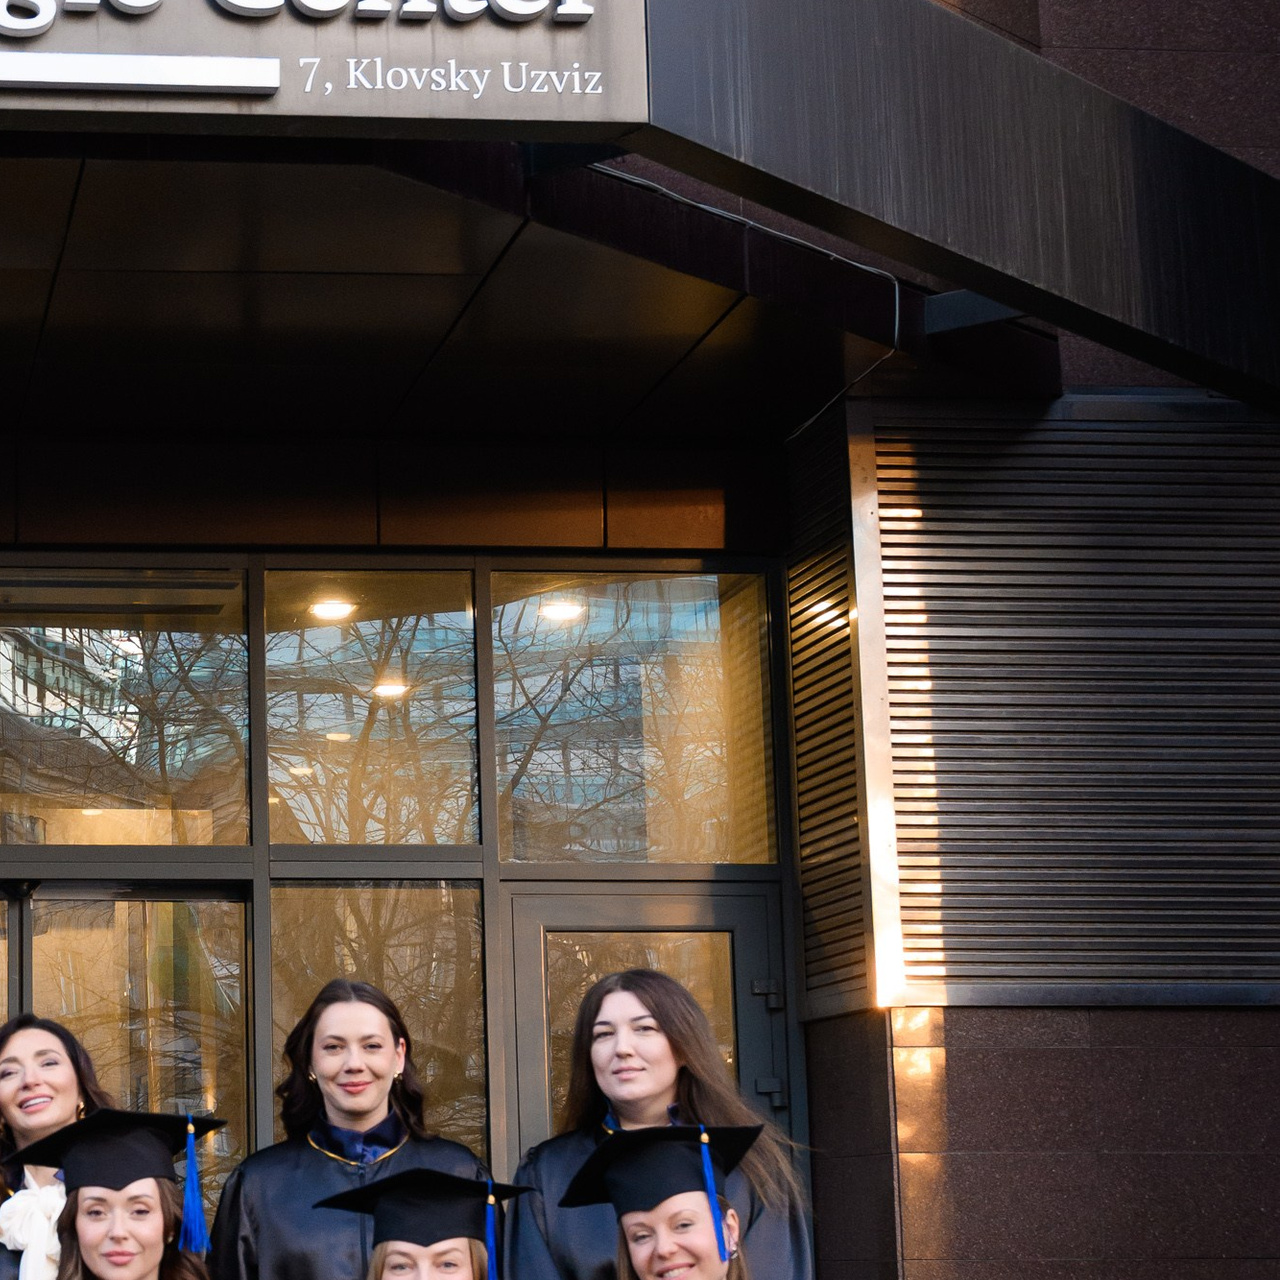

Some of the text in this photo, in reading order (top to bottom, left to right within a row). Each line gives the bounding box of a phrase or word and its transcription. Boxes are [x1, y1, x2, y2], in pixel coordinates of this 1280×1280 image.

[298, 57, 603, 100] 7, Klovsky Uzviz
